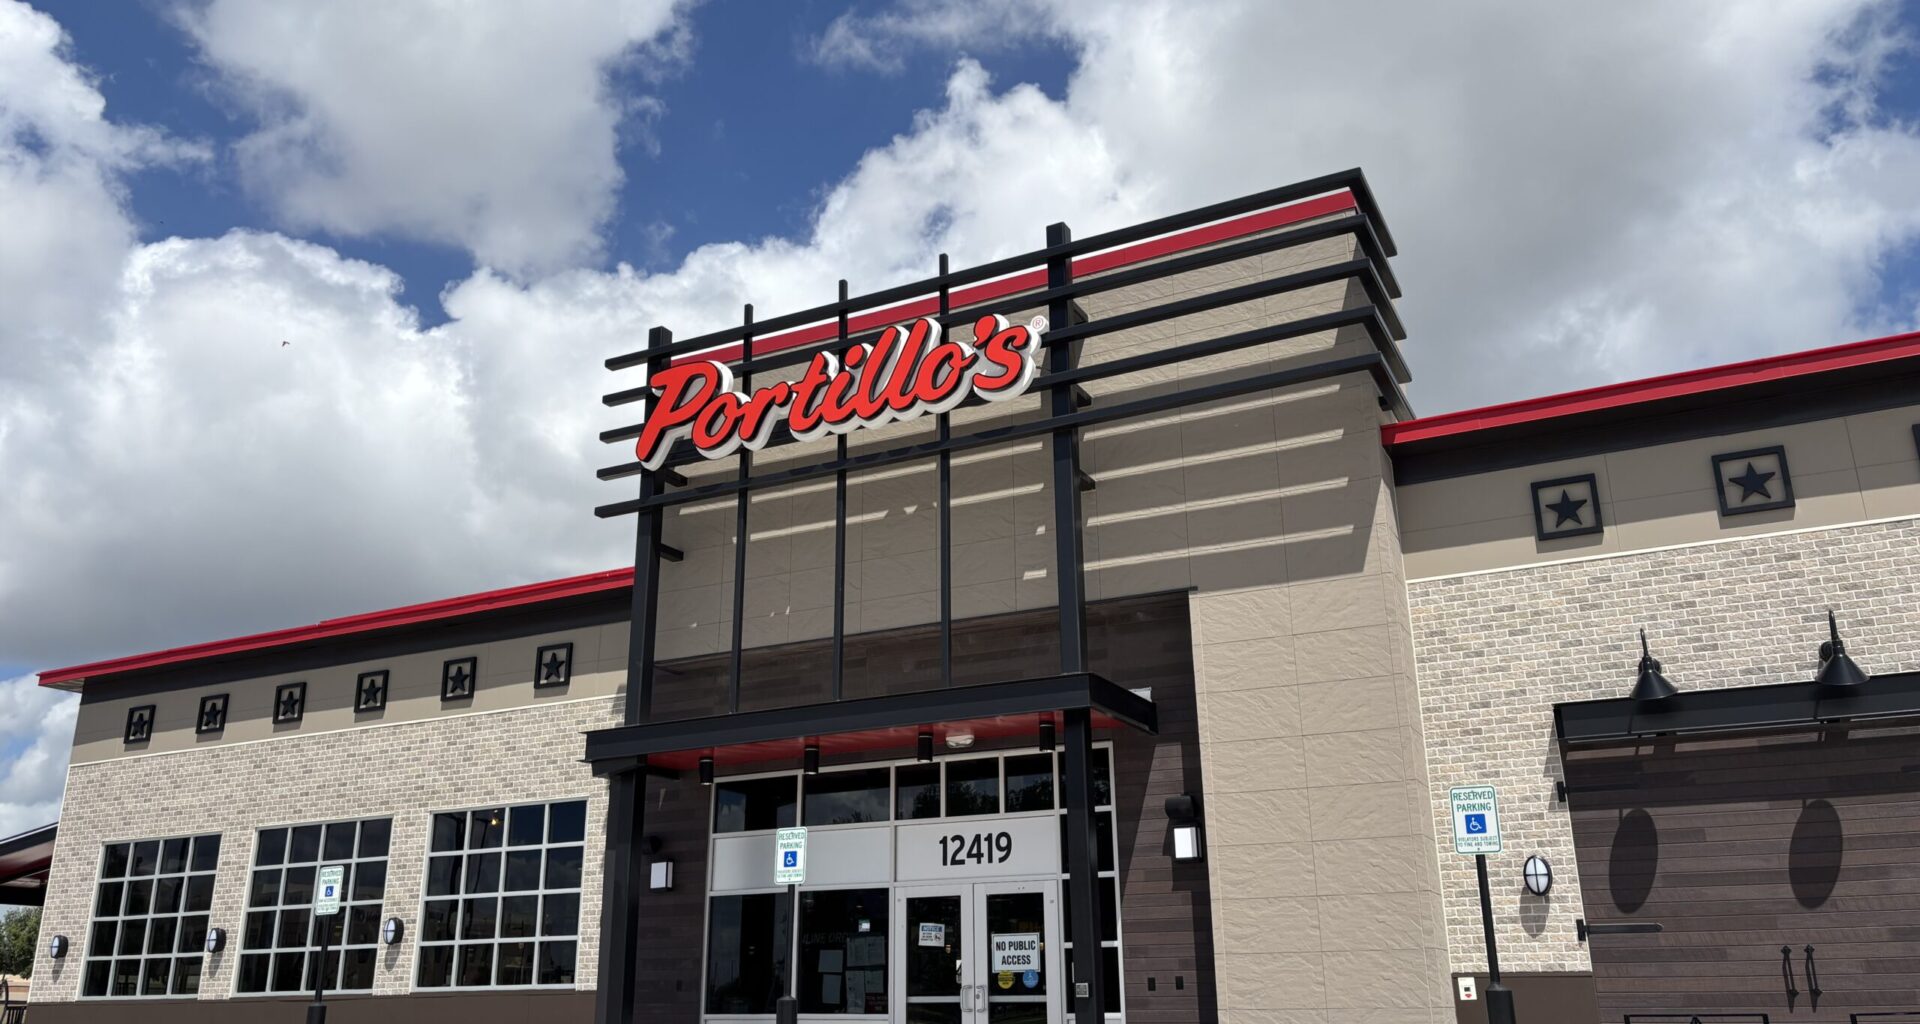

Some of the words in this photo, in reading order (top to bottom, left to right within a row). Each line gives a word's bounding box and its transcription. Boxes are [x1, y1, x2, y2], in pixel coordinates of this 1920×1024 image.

[636, 314, 1040, 467] Portillo's
[1453, 791, 1493, 801] RESERVED
[1456, 802, 1492, 812] PARKING
[778, 832, 805, 840] RESERVED
[780, 841, 803, 849] PARKING
[939, 831, 1012, 866] 12419
[995, 941, 1006, 951] NO
[1008, 940, 1036, 951] PUBLIC
[1001, 955, 1031, 965] ACCESS
